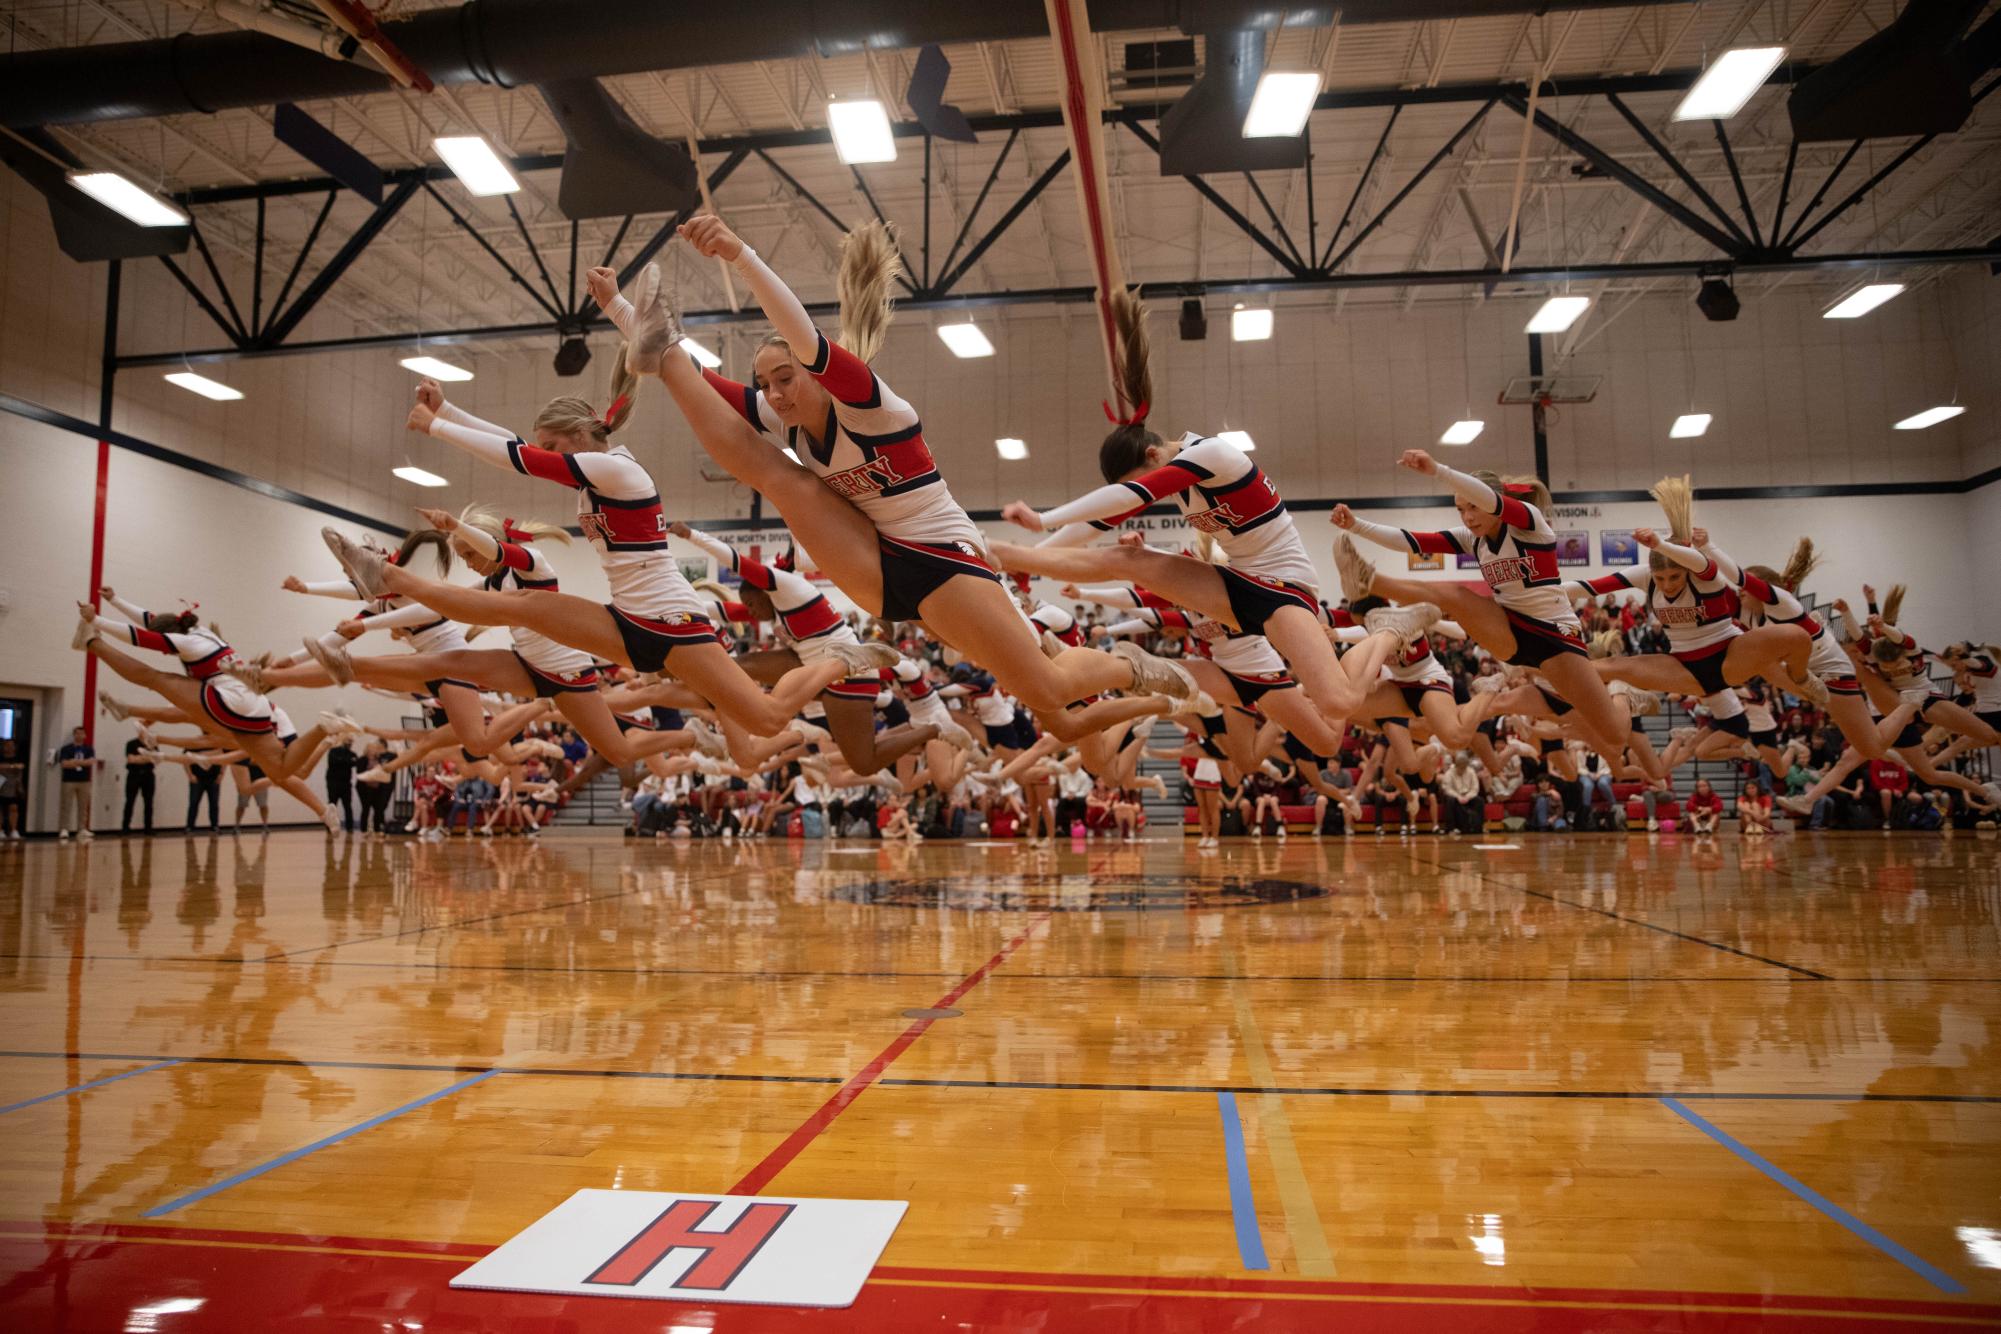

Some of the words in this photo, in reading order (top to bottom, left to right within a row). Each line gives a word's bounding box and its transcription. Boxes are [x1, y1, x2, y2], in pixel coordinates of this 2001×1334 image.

[822, 455, 903, 498] ERTY
[1480, 556, 1540, 587] BERTY
[580, 1199, 798, 1291] H
